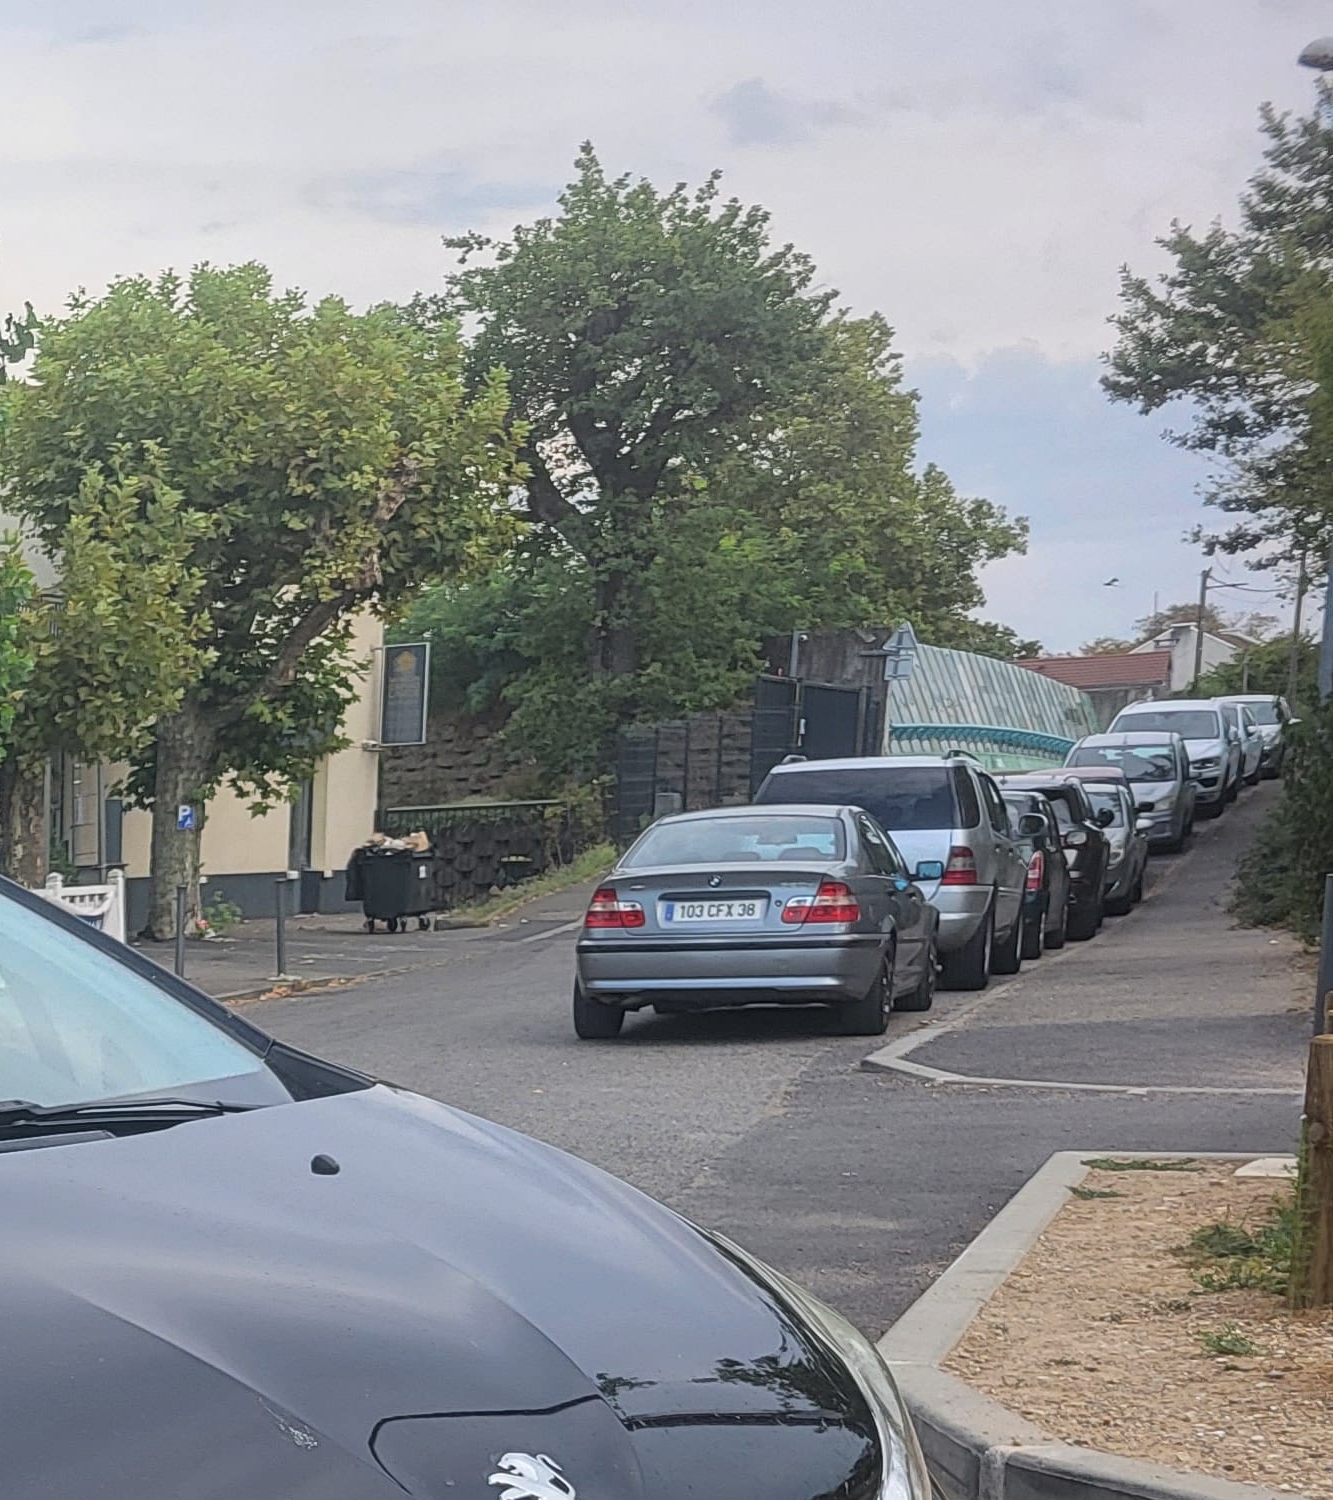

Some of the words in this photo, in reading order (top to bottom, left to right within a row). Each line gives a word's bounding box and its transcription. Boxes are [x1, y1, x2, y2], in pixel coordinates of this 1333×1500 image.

[178, 804, 191, 822] P
[680, 904, 704, 919] 103
[707, 903, 734, 917] CFX
[737, 903, 756, 917] 38
